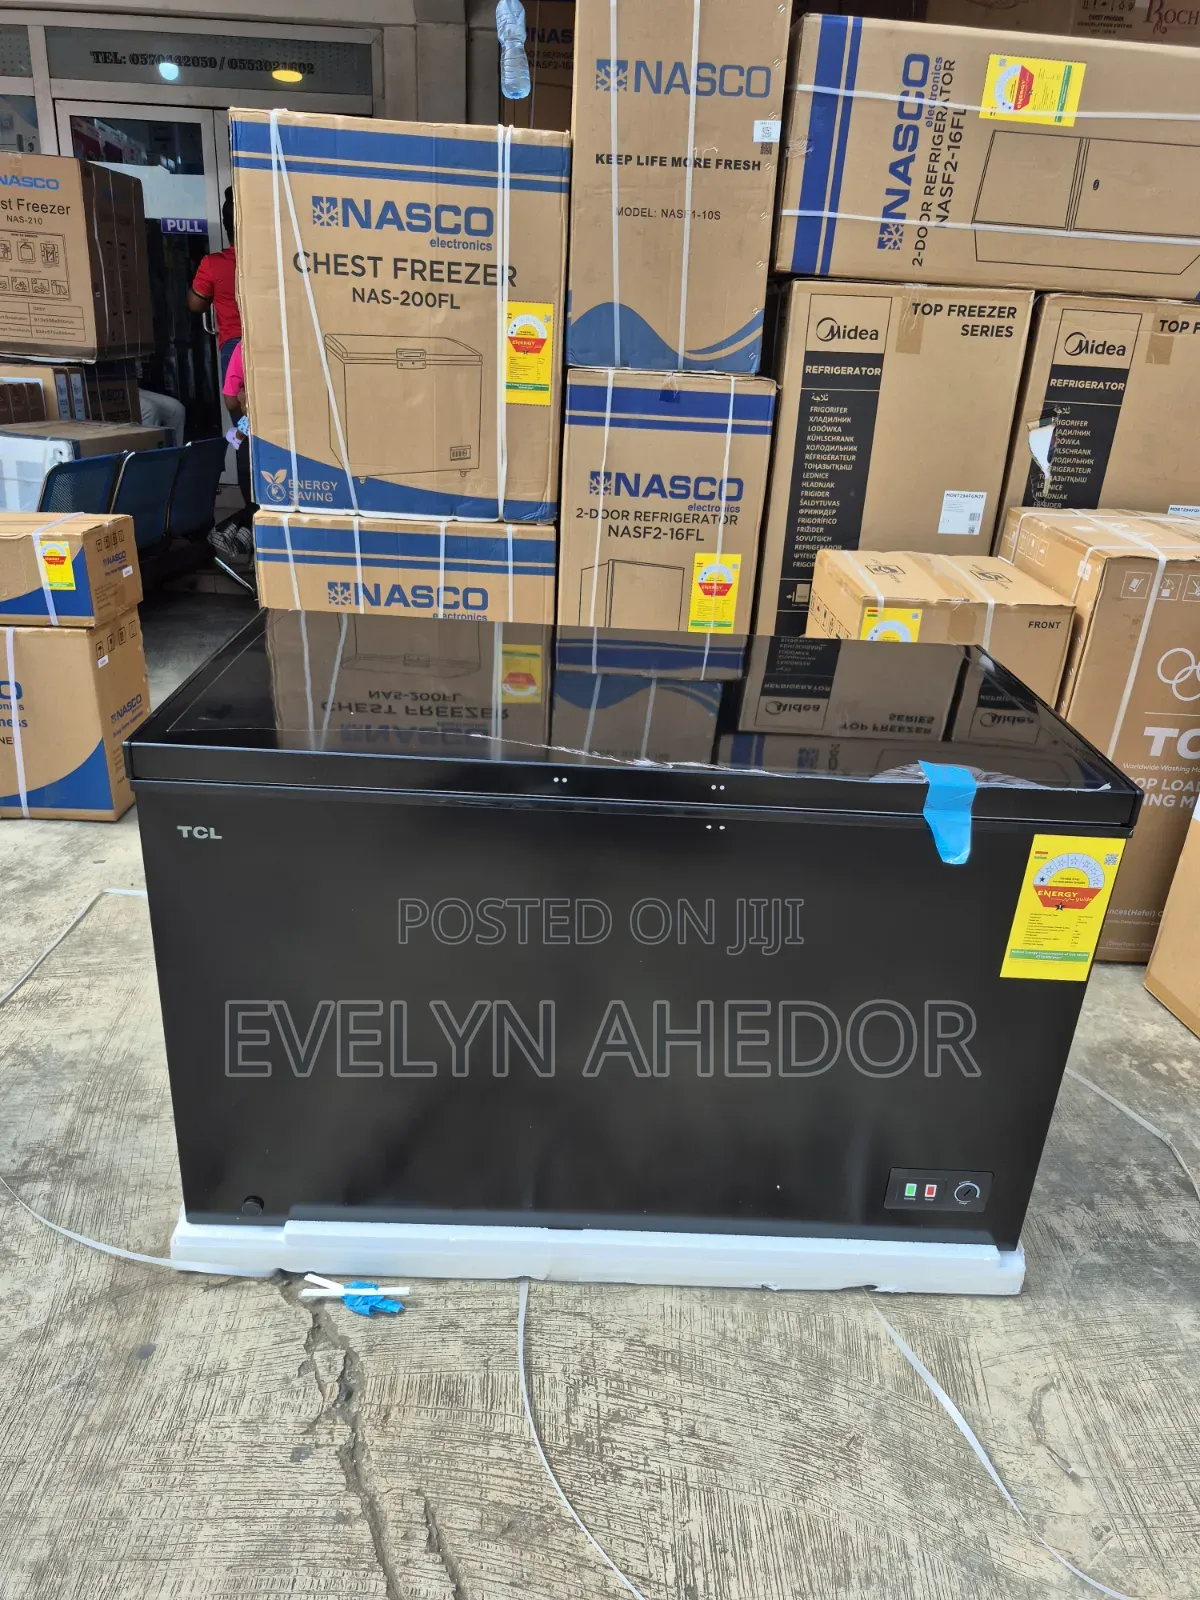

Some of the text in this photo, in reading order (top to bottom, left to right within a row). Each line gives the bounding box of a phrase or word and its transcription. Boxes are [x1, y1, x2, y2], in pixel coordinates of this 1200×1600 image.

[530, 28, 574, 43] NAS
[90, 51, 127, 65] TEL:
[634, 60, 771, 98] NASCO
[882, 53, 930, 221] NASCO
[595, 153, 761, 171] KEEP LIFE MORE FRESH
[912, 60, 956, 267] 2-DOOR REFRIGERATOR
[17, 198, 71, 215] Freezer
[616, 206, 721, 220] MODEL: NAS1-10S
[6, 215, 43, 225] NAS-210
[341, 197, 494, 238] NASCO
[166, 219, 203, 232] PULL
[430, 237, 493, 251] electronics
[293, 251, 517, 288] CHEST FREEZER
[352, 287, 461, 310] NAS-200FL
[912, 302, 1017, 319] TOP FREEZER
[816, 316, 879, 342] Midea
[960, 324, 1014, 338] SERIES
[1159, 320, 1190, 333] TOP
[1064, 332, 1126, 356] Midea
[805, 364, 882, 376] REFRIGERATOR
[1050, 379, 1125, 391] REFRIGERATOR
[810, 406, 848, 414] FRIGORIFER
[807, 425, 842, 433] LODÓWKA
[806, 434, 855, 442] KÜHLSCHRANK
[288, 479, 338, 491] ENERGY
[614, 472, 744, 502] NASCO
[801, 481, 835, 489] HLADNJAK
[1037, 482, 1063, 490] LENICE
[289, 490, 333, 502] SAVING
[800, 490, 830, 498] FRIGIDER
[576, 508, 738, 526] 2-DOOR REFRIGERATOR
[608, 524, 705, 542] NASF2-16FL
[354, 583, 489, 611] NASCO
[432, 612, 488, 621] eectronics
[1028, 620, 1061, 629] FRONT
[116, 693, 142, 718] NASCO
[1144, 726, 1200, 759] TC
[1123, 763, 1159, 771] Worldwide
[1160, 765, 1191, 773] Washing
[1142, 793, 1176, 807] ING
[177, 825, 222, 839] TCL
[1038, 889, 1079, 898] ENERGY
